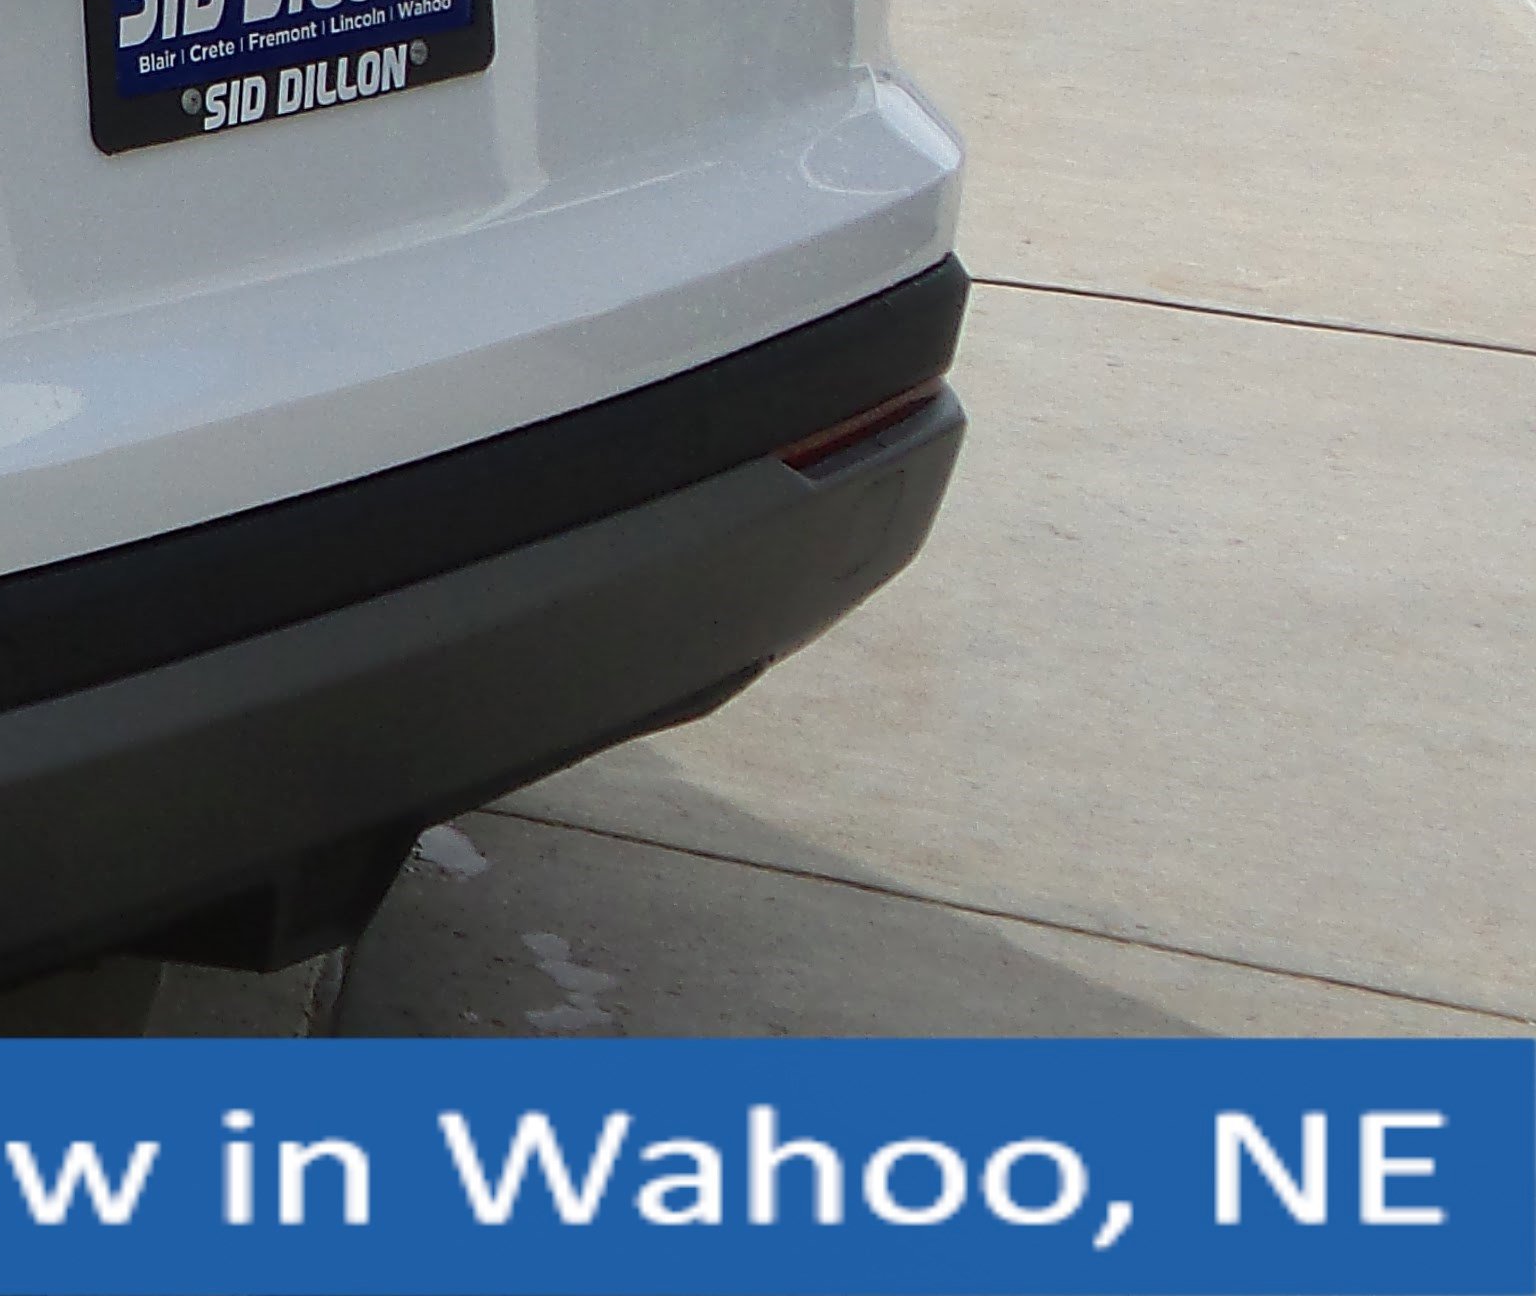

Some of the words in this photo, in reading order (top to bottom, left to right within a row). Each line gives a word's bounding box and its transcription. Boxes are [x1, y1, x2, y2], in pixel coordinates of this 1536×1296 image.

[139, 50, 176, 74] Blair
[190, 38, 235, 63] Crete
[248, 21, 317, 51] Fremont
[330, 6, 386, 35] Lincoln
[203, 75, 267, 131] SID
[277, 43, 409, 116] DILLON
